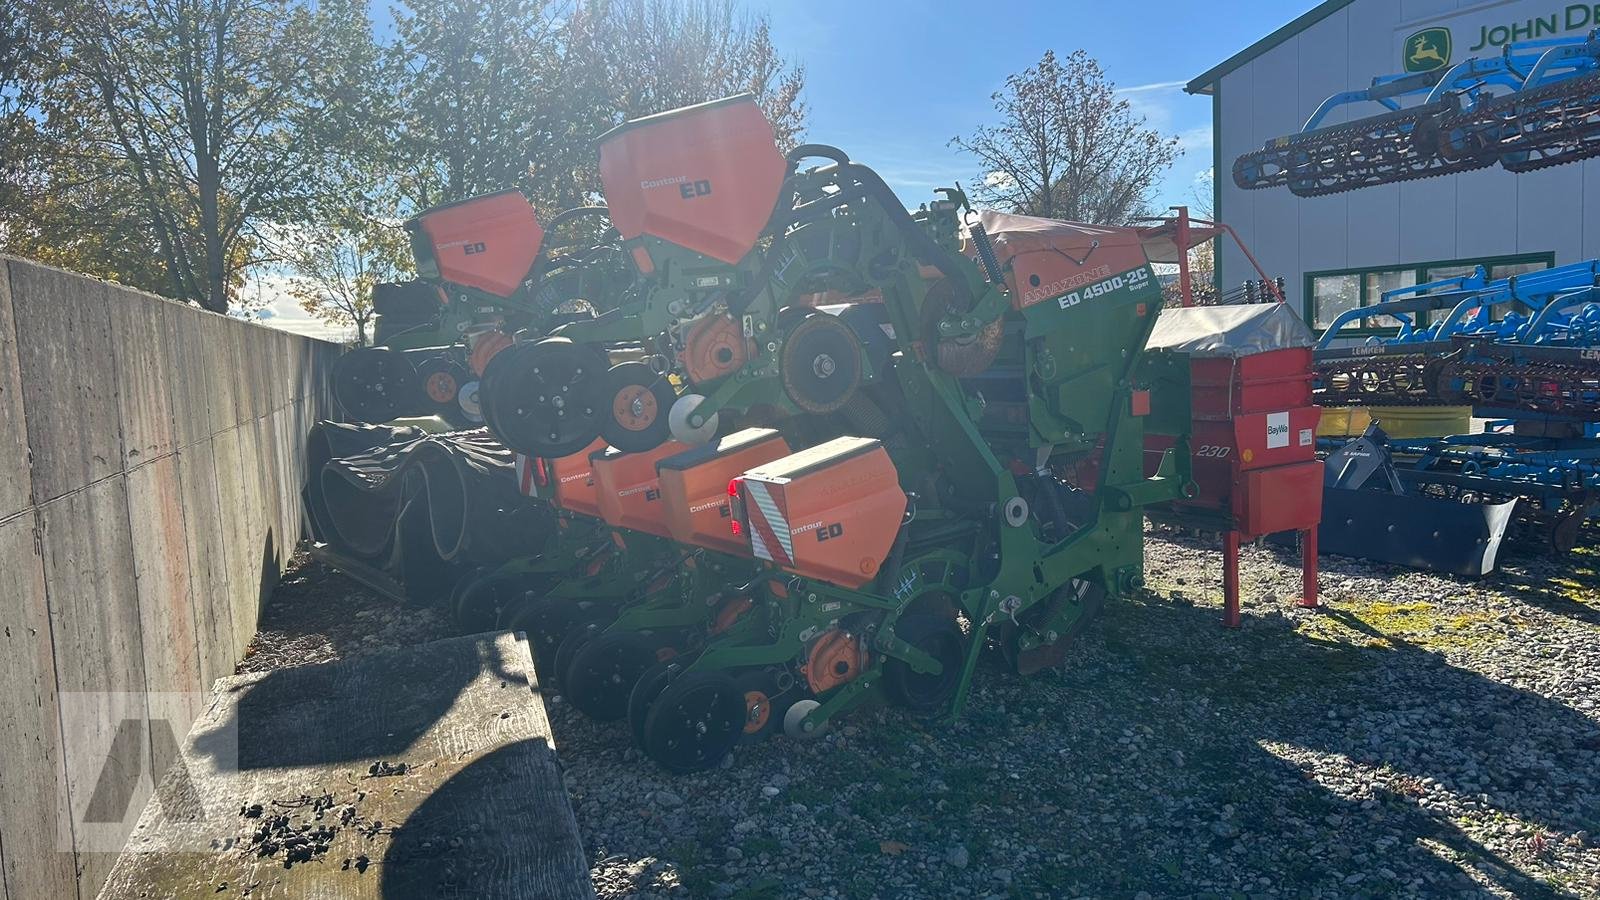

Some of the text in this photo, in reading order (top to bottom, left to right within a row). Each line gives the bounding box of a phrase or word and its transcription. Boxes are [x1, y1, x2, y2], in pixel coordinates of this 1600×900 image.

[1469, 13, 1557, 51] JOHN
[640, 175, 687, 189] Contour
[680, 180, 711, 199] ED
[463, 242, 487, 255] ED
[1024, 265, 1112, 304] AMAZONE
[1058, 267, 1148, 310] ED 4500-2C
[1129, 281, 1149, 292] Super
[1267, 424, 1288, 435] BayWa
[1197, 445, 1231, 458] 230
[560, 472, 590, 483] Contour
[690, 500, 725, 513] Contour
[790, 521, 823, 535] ontour
[816, 523, 843, 542] ED
